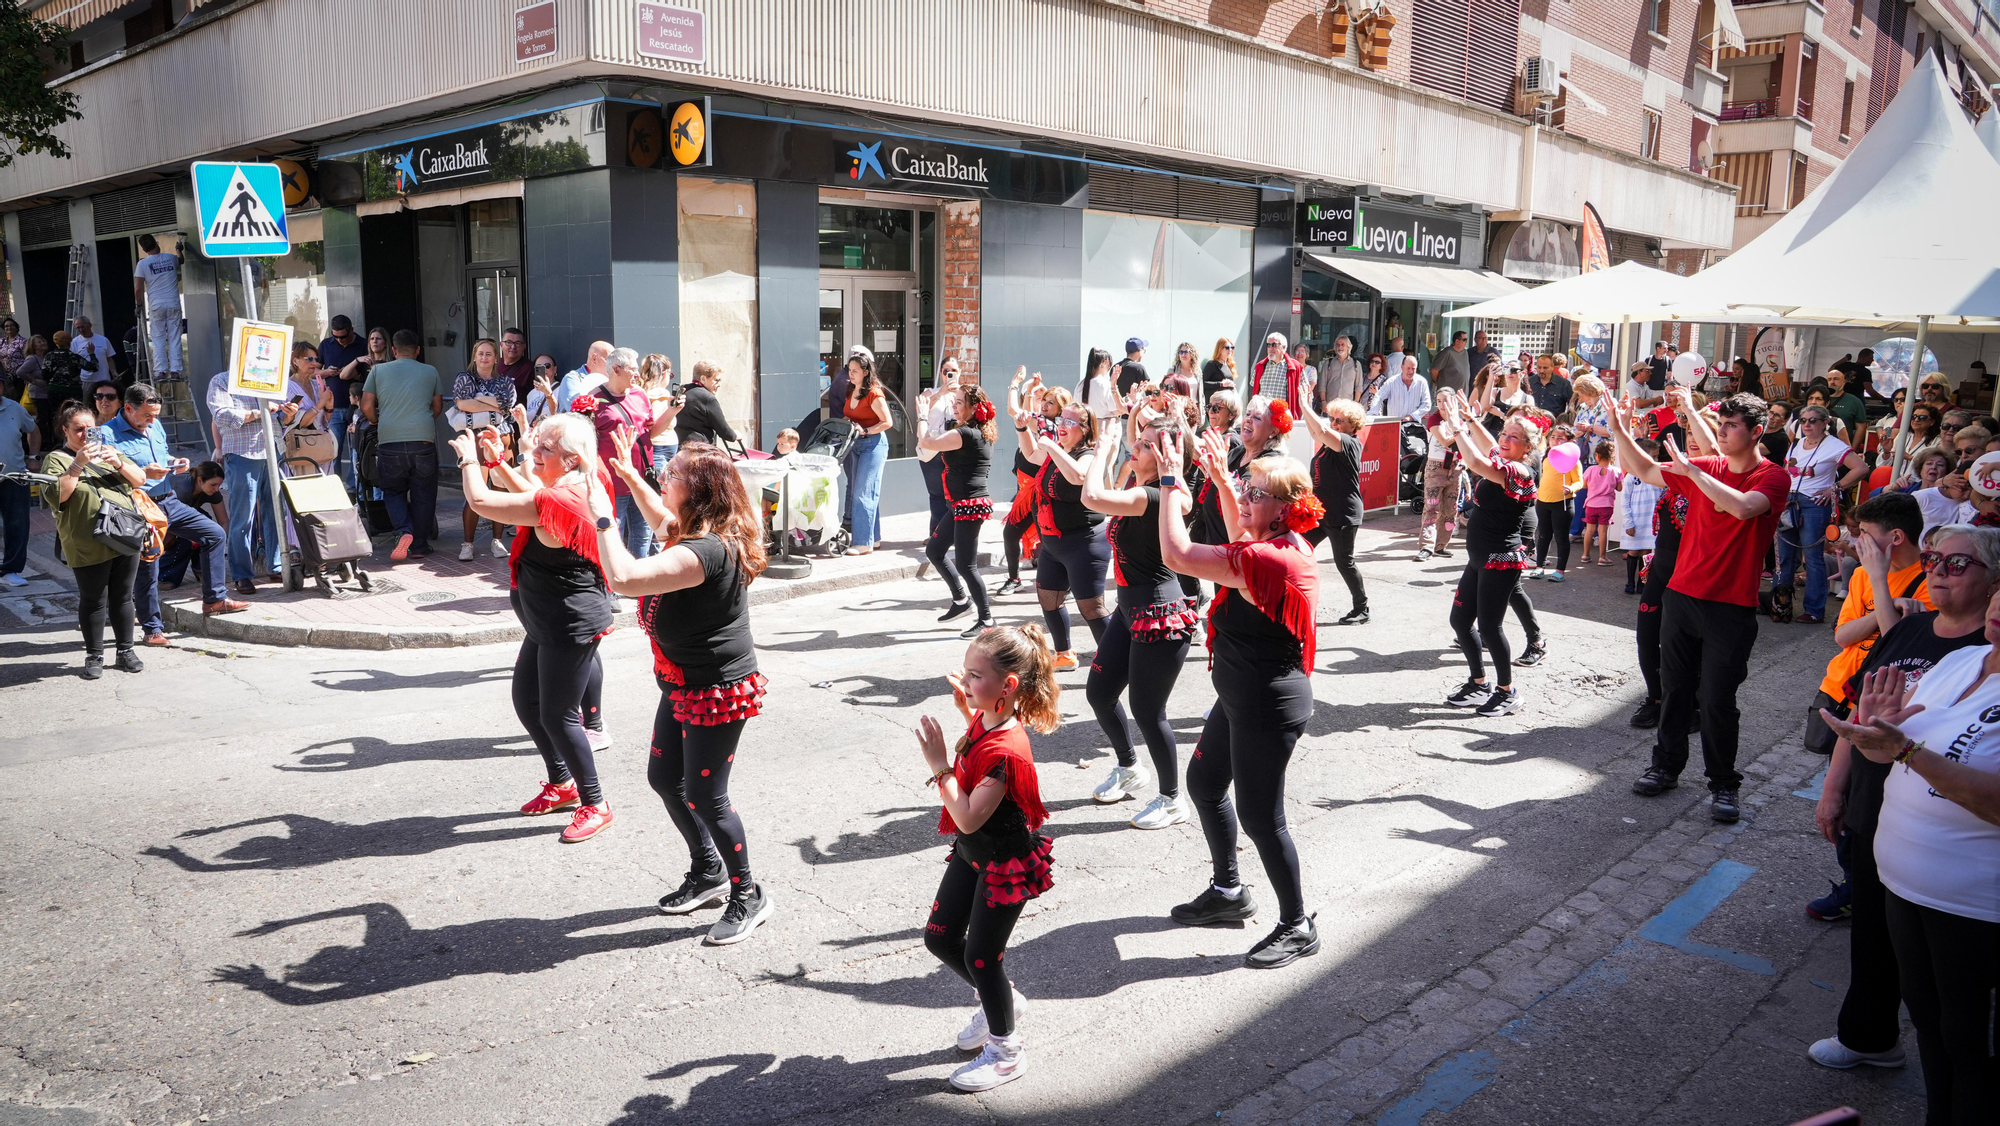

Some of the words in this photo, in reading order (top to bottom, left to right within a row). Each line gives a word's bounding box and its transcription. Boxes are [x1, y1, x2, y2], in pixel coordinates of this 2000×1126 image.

[660, 12, 695, 27] Avenida
[516, 30, 534, 45] Ángela
[534, 27, 555, 39] Romero
[660, 26, 683, 39] Jesús
[524, 45, 532, 55] de
[531, 43, 547, 53] Torres
[649, 37, 694, 54] Rescatado
[420, 138, 489, 175] CaixaBank
[891, 146, 989, 183] CaixaBank
[1308, 205, 1352, 221] Nueva
[1310, 227, 1347, 242] Linea
[1413, 221, 1457, 260] Linea
[1694, 367, 1705, 375] 50
[1359, 460, 1380, 475] ampo
[1961, 730, 1985, 765] LAMENCO
